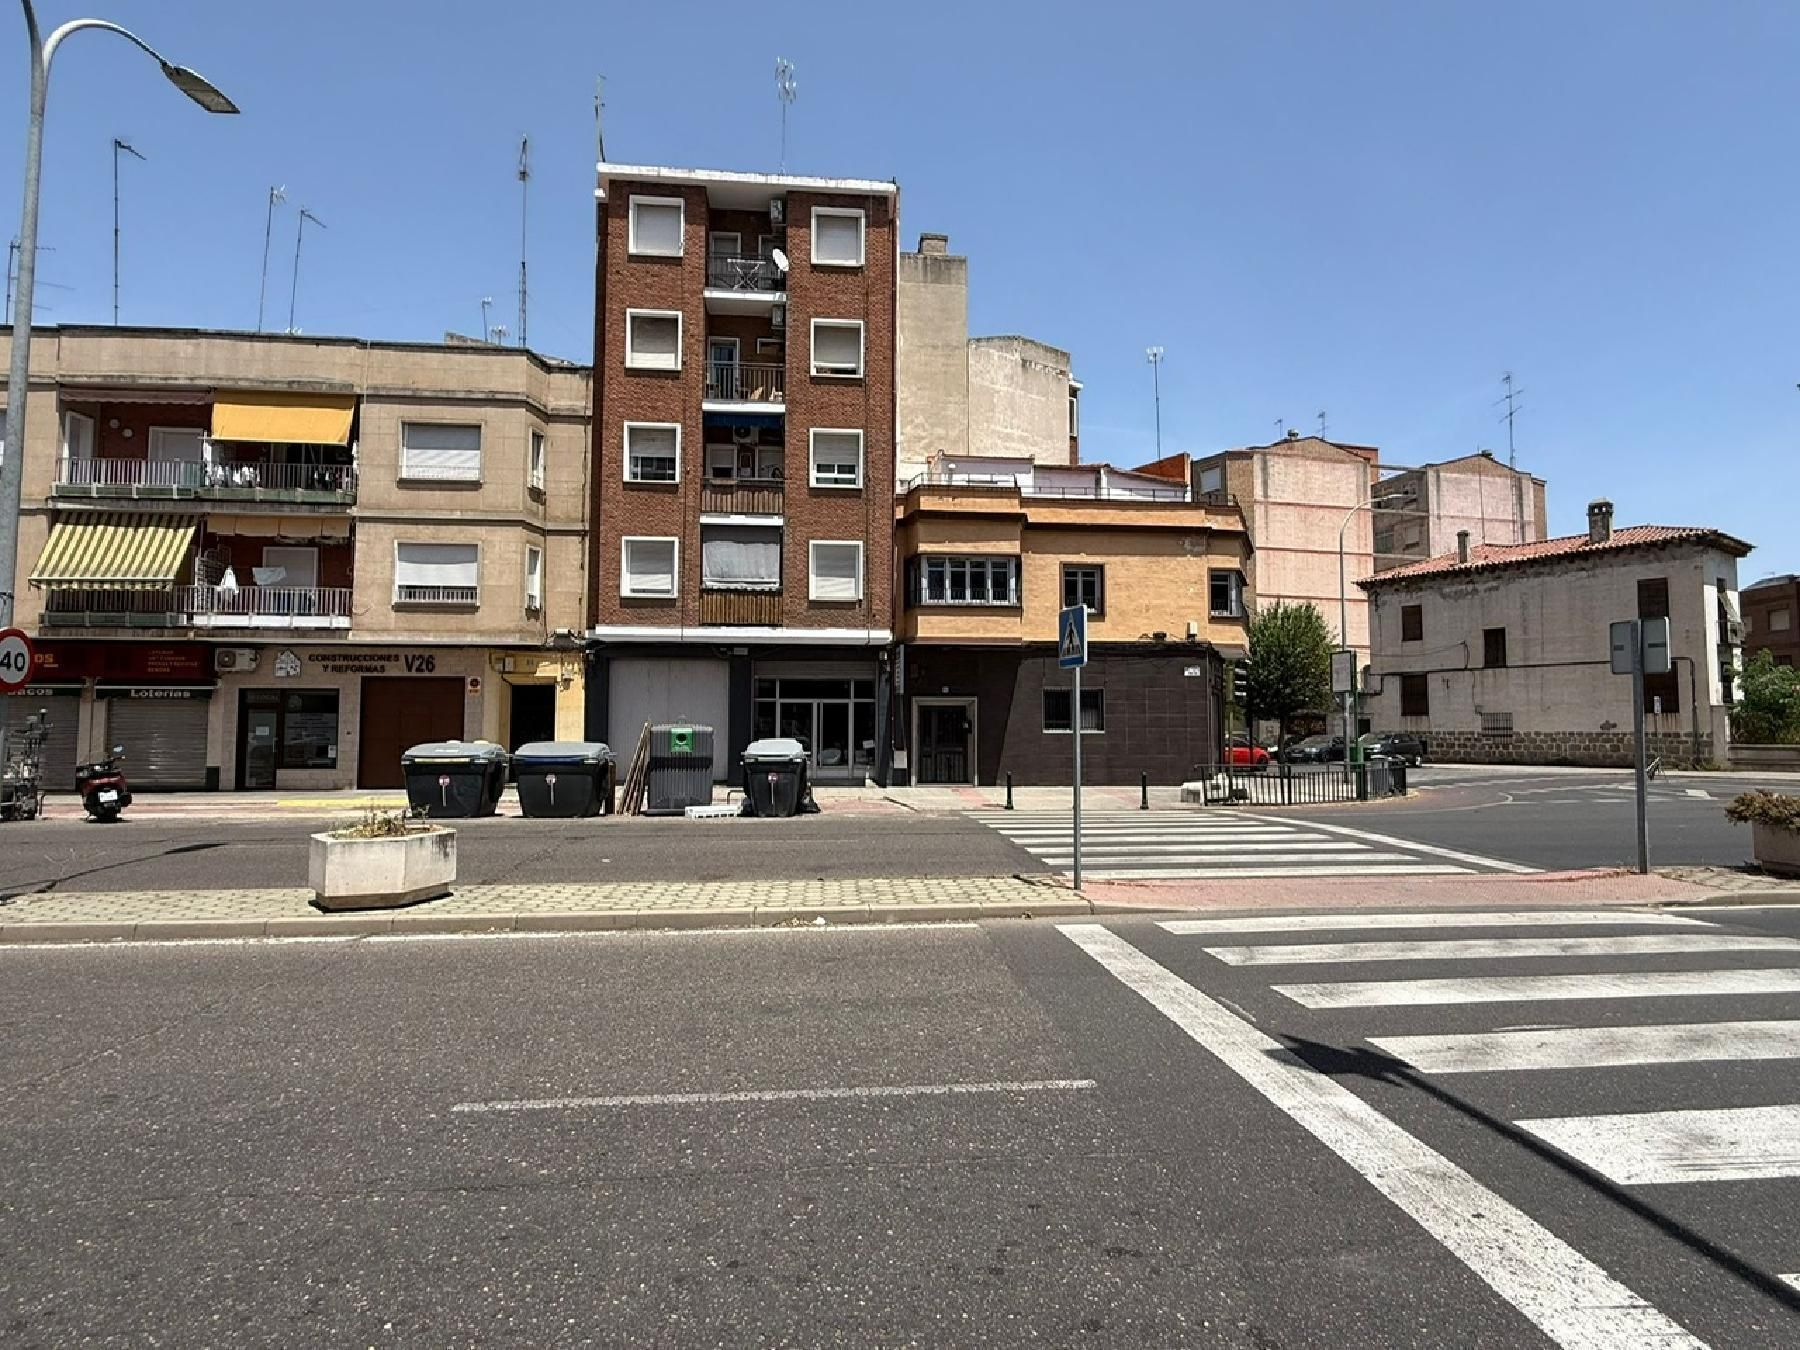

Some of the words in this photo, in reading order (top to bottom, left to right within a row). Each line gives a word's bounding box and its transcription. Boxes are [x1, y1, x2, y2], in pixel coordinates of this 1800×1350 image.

[0, 651, 26, 672] 40
[308, 654, 399, 662] CONSTRUCCIONES
[404, 654, 436, 672] V26
[322, 664, 329, 673] Y
[331, 664, 386, 673] REFORMAS
